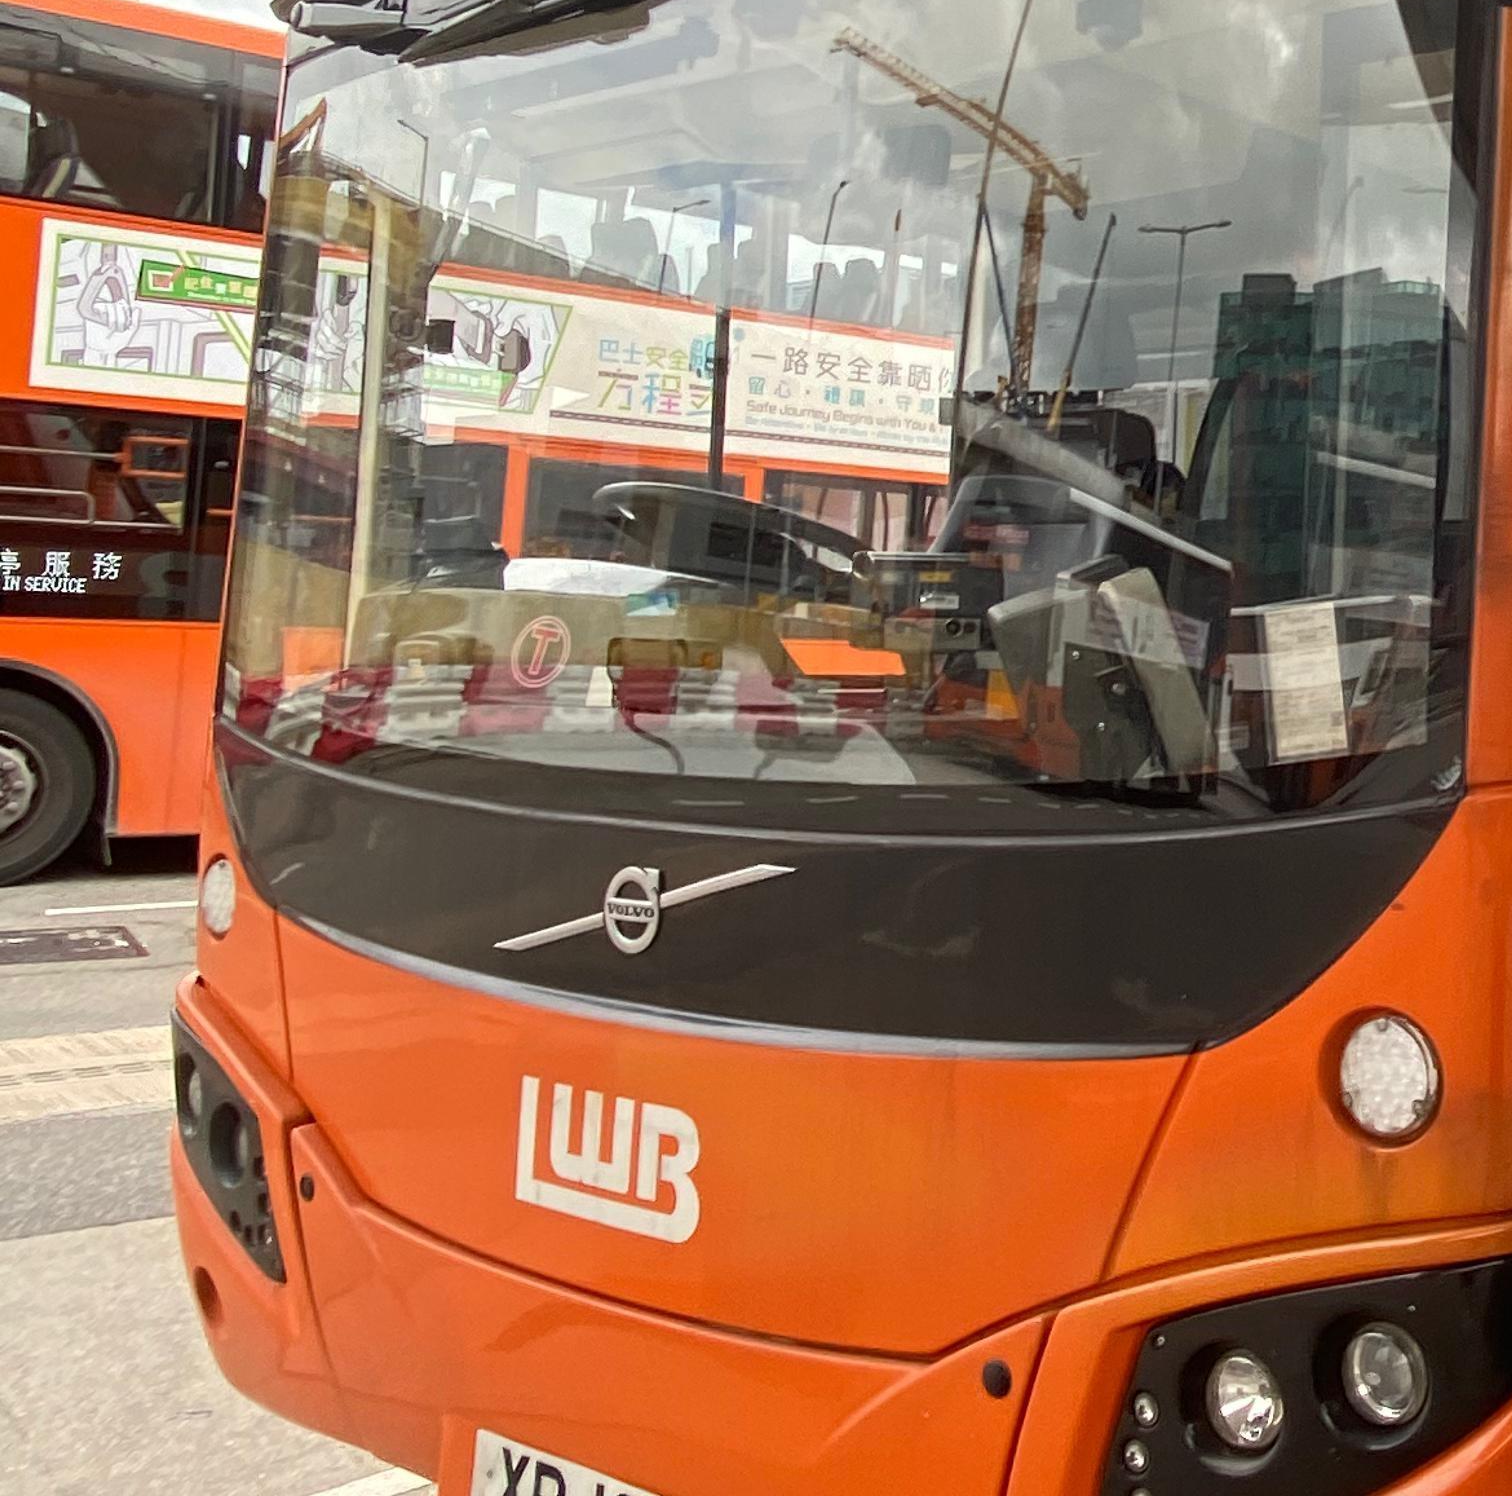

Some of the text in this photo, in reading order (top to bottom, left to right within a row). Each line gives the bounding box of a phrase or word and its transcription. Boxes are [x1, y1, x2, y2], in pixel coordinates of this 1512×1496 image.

[597, 338, 690, 372] 巴士安全
[746, 399, 777, 415] Safe
[779, 403, 831, 423] Journey
[832, 409, 874, 426] Begins
[903, 417, 927, 432] You
[2, 575, 88, 594] IN SERVICE
[607, 902, 656, 919] VOLVO
[514, 1074, 701, 1244] LWB
